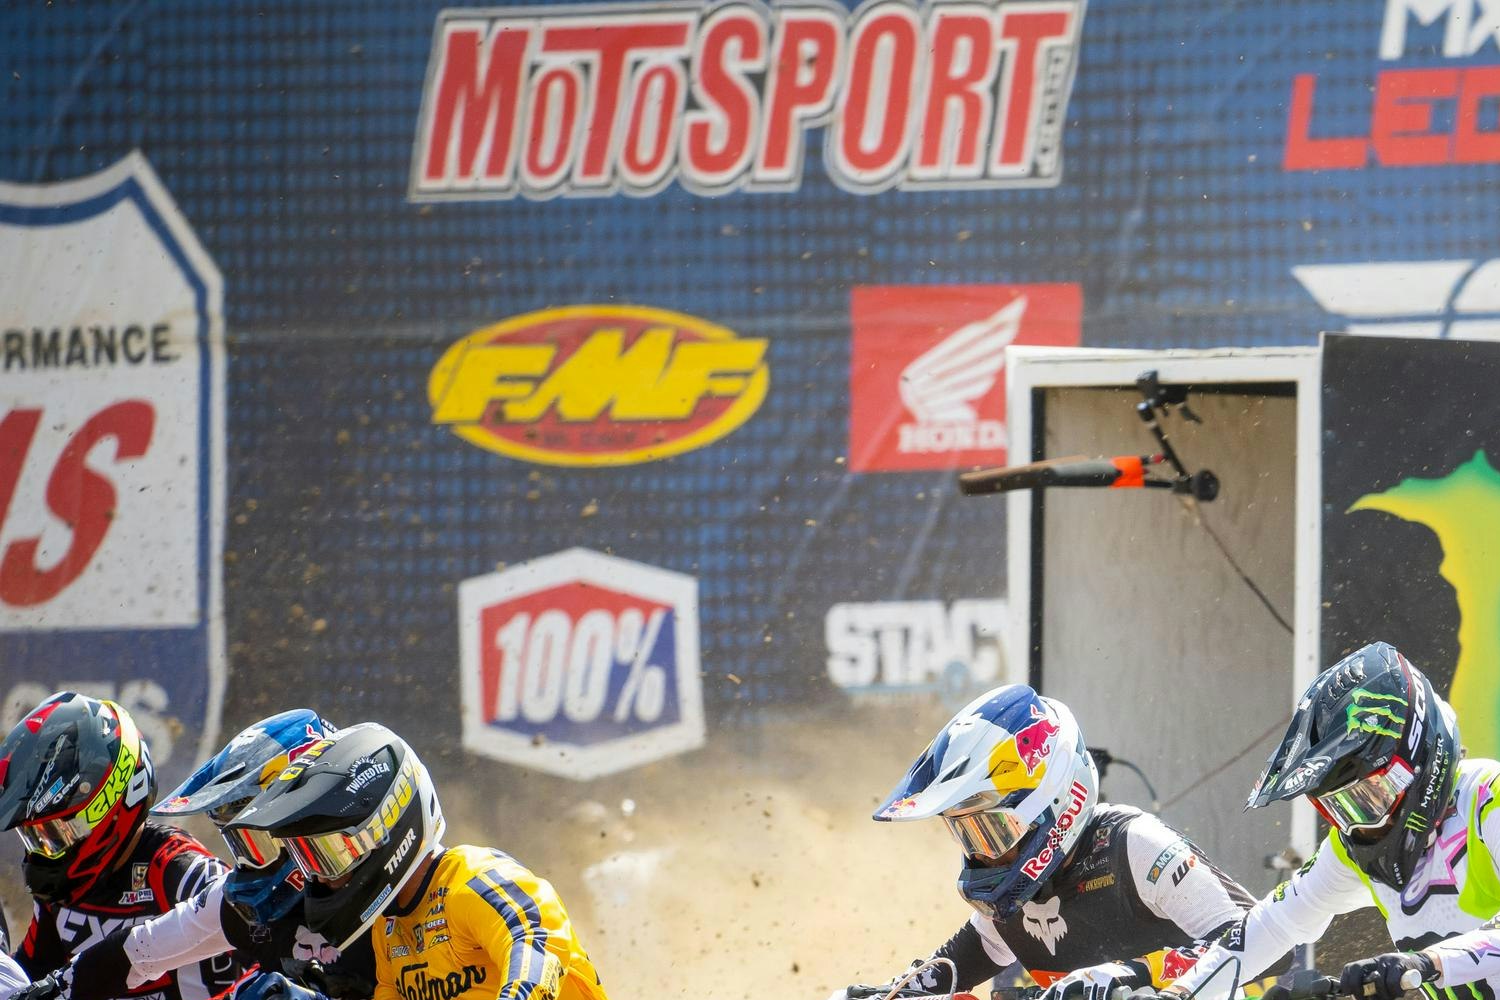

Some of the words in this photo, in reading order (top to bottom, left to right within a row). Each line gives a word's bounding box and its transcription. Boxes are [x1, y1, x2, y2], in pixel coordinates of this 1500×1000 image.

[432, 325, 769, 426] FMF
[896, 420, 1007, 453] HOND
[496, 608, 667, 723] 100%
[346, 767, 376, 794] TWISTED
[373, 762, 391, 776] TEA
[1420, 737, 1444, 808] MONSTER
[384, 828, 417, 875] THOR
